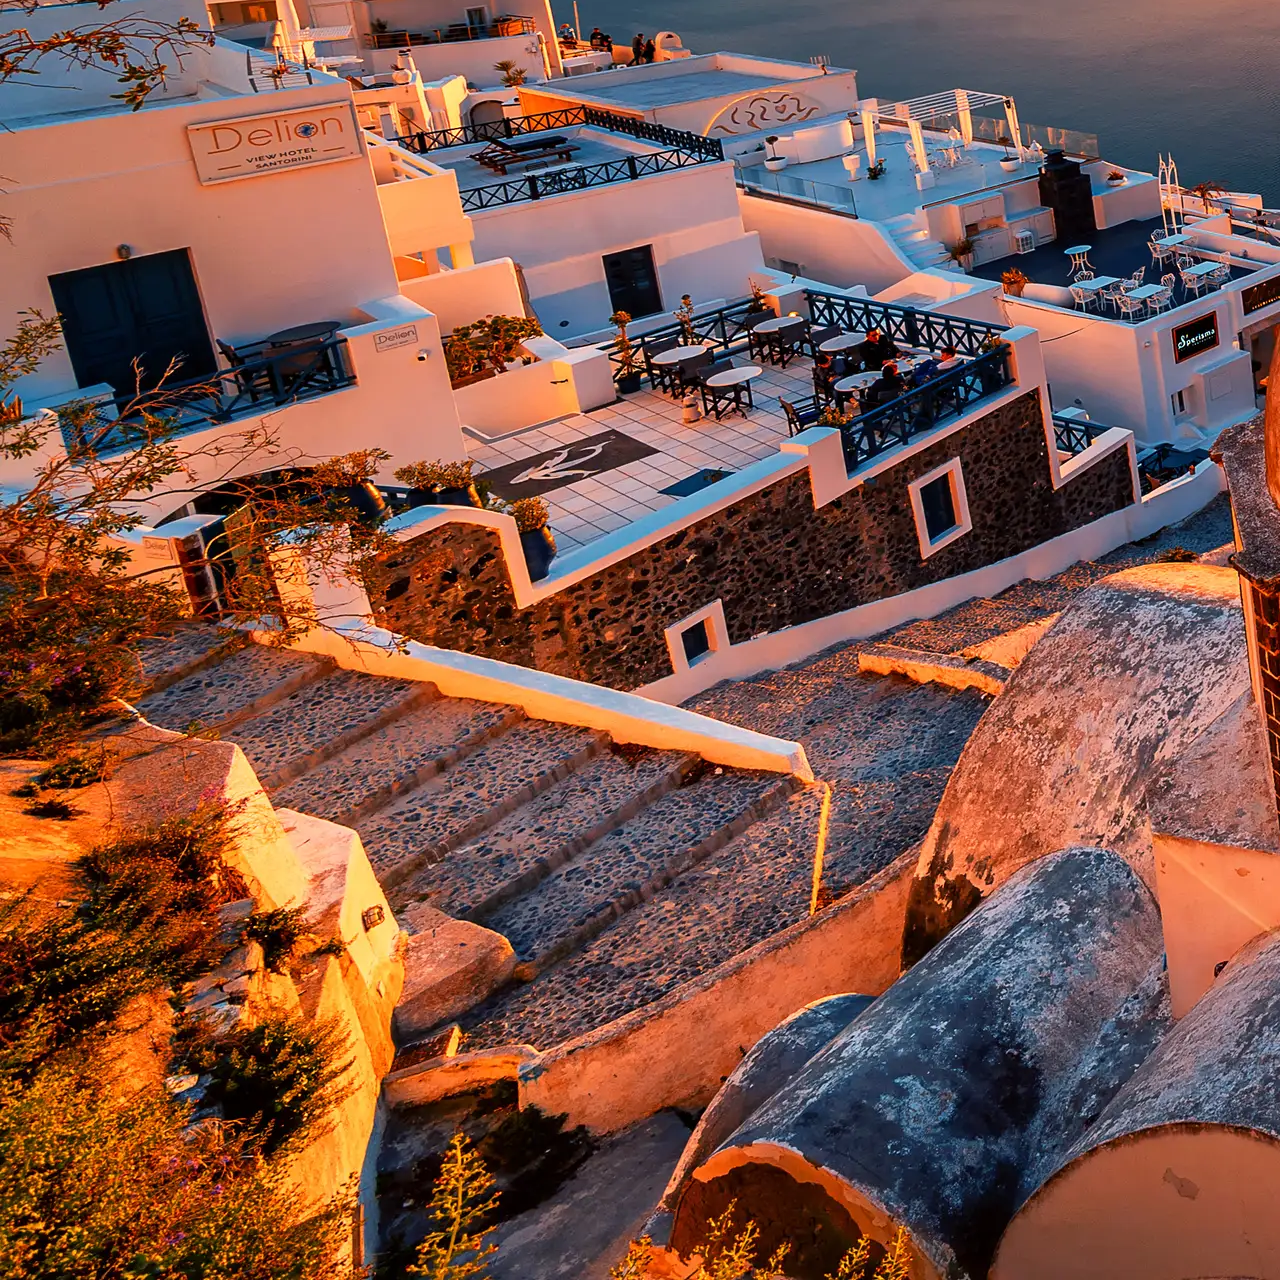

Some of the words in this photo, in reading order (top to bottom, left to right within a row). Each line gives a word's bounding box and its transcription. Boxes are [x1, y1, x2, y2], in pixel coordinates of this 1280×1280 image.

[207, 117, 344, 155] Delion
[246, 153, 277, 164] VIEW
[279, 147, 318, 158] HOTEL
[255, 155, 312, 169] SANTORINI
[377, 330, 415, 344] Delion
